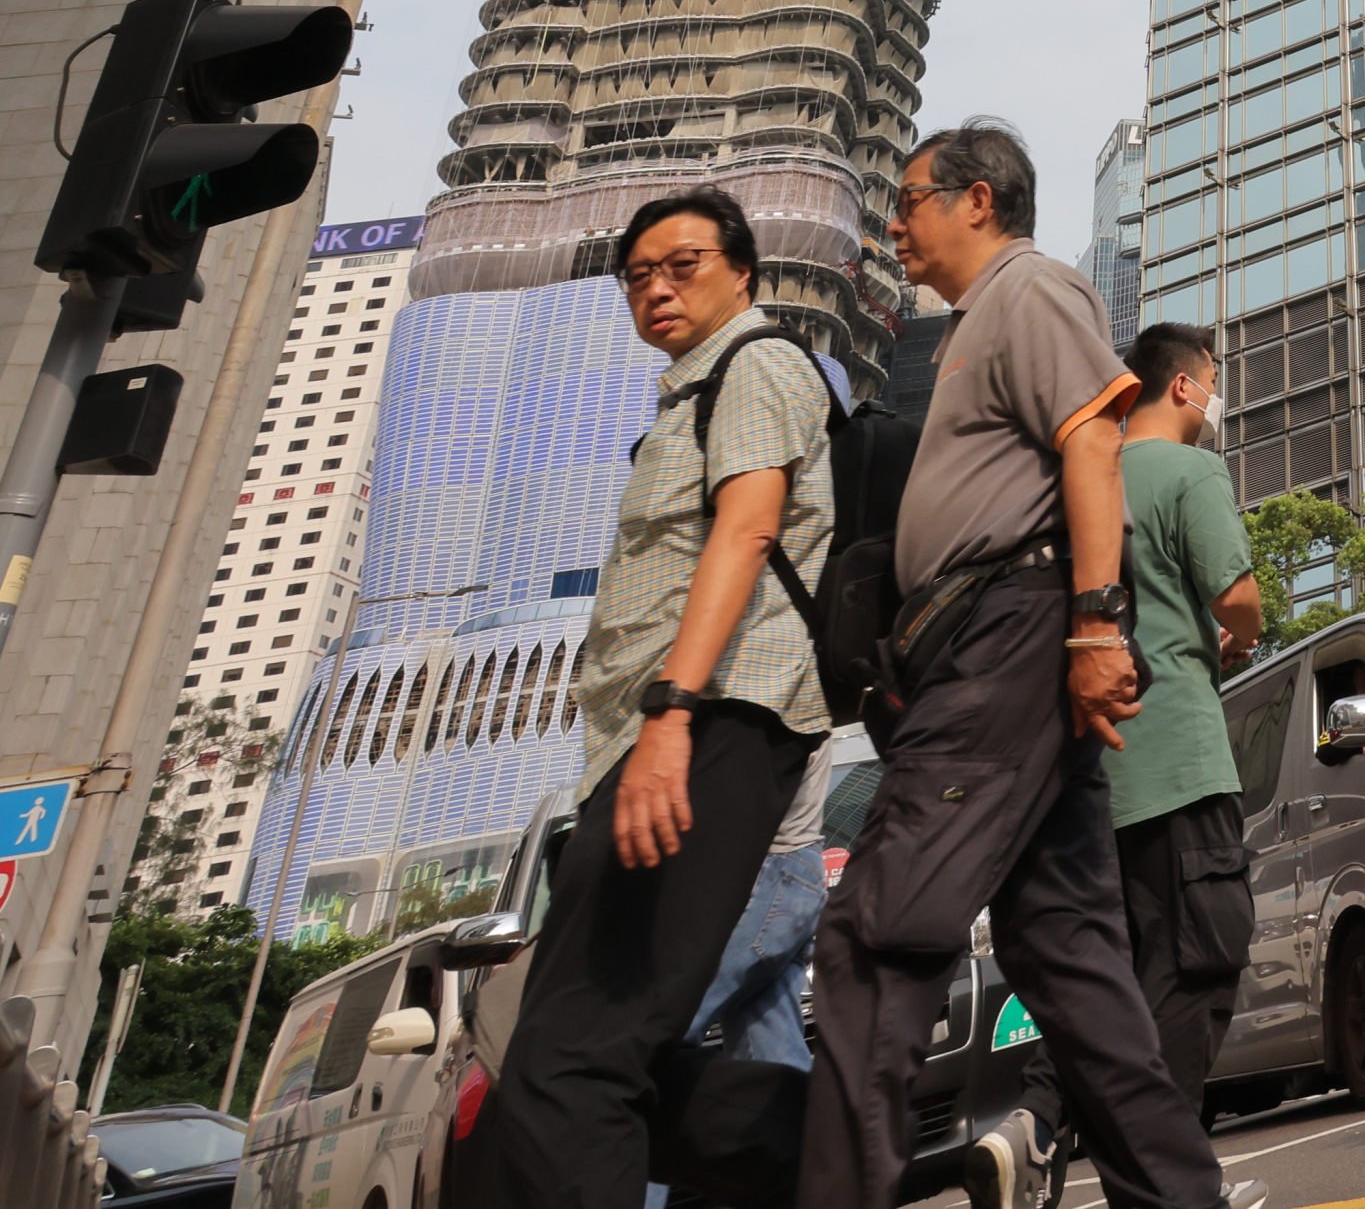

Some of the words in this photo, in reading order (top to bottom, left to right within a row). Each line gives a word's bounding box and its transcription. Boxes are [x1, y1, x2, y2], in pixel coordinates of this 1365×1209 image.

[313, 228, 352, 252] NK
[361, 222, 407, 247] OF
[1009, 1024, 1036, 1043] SEA
